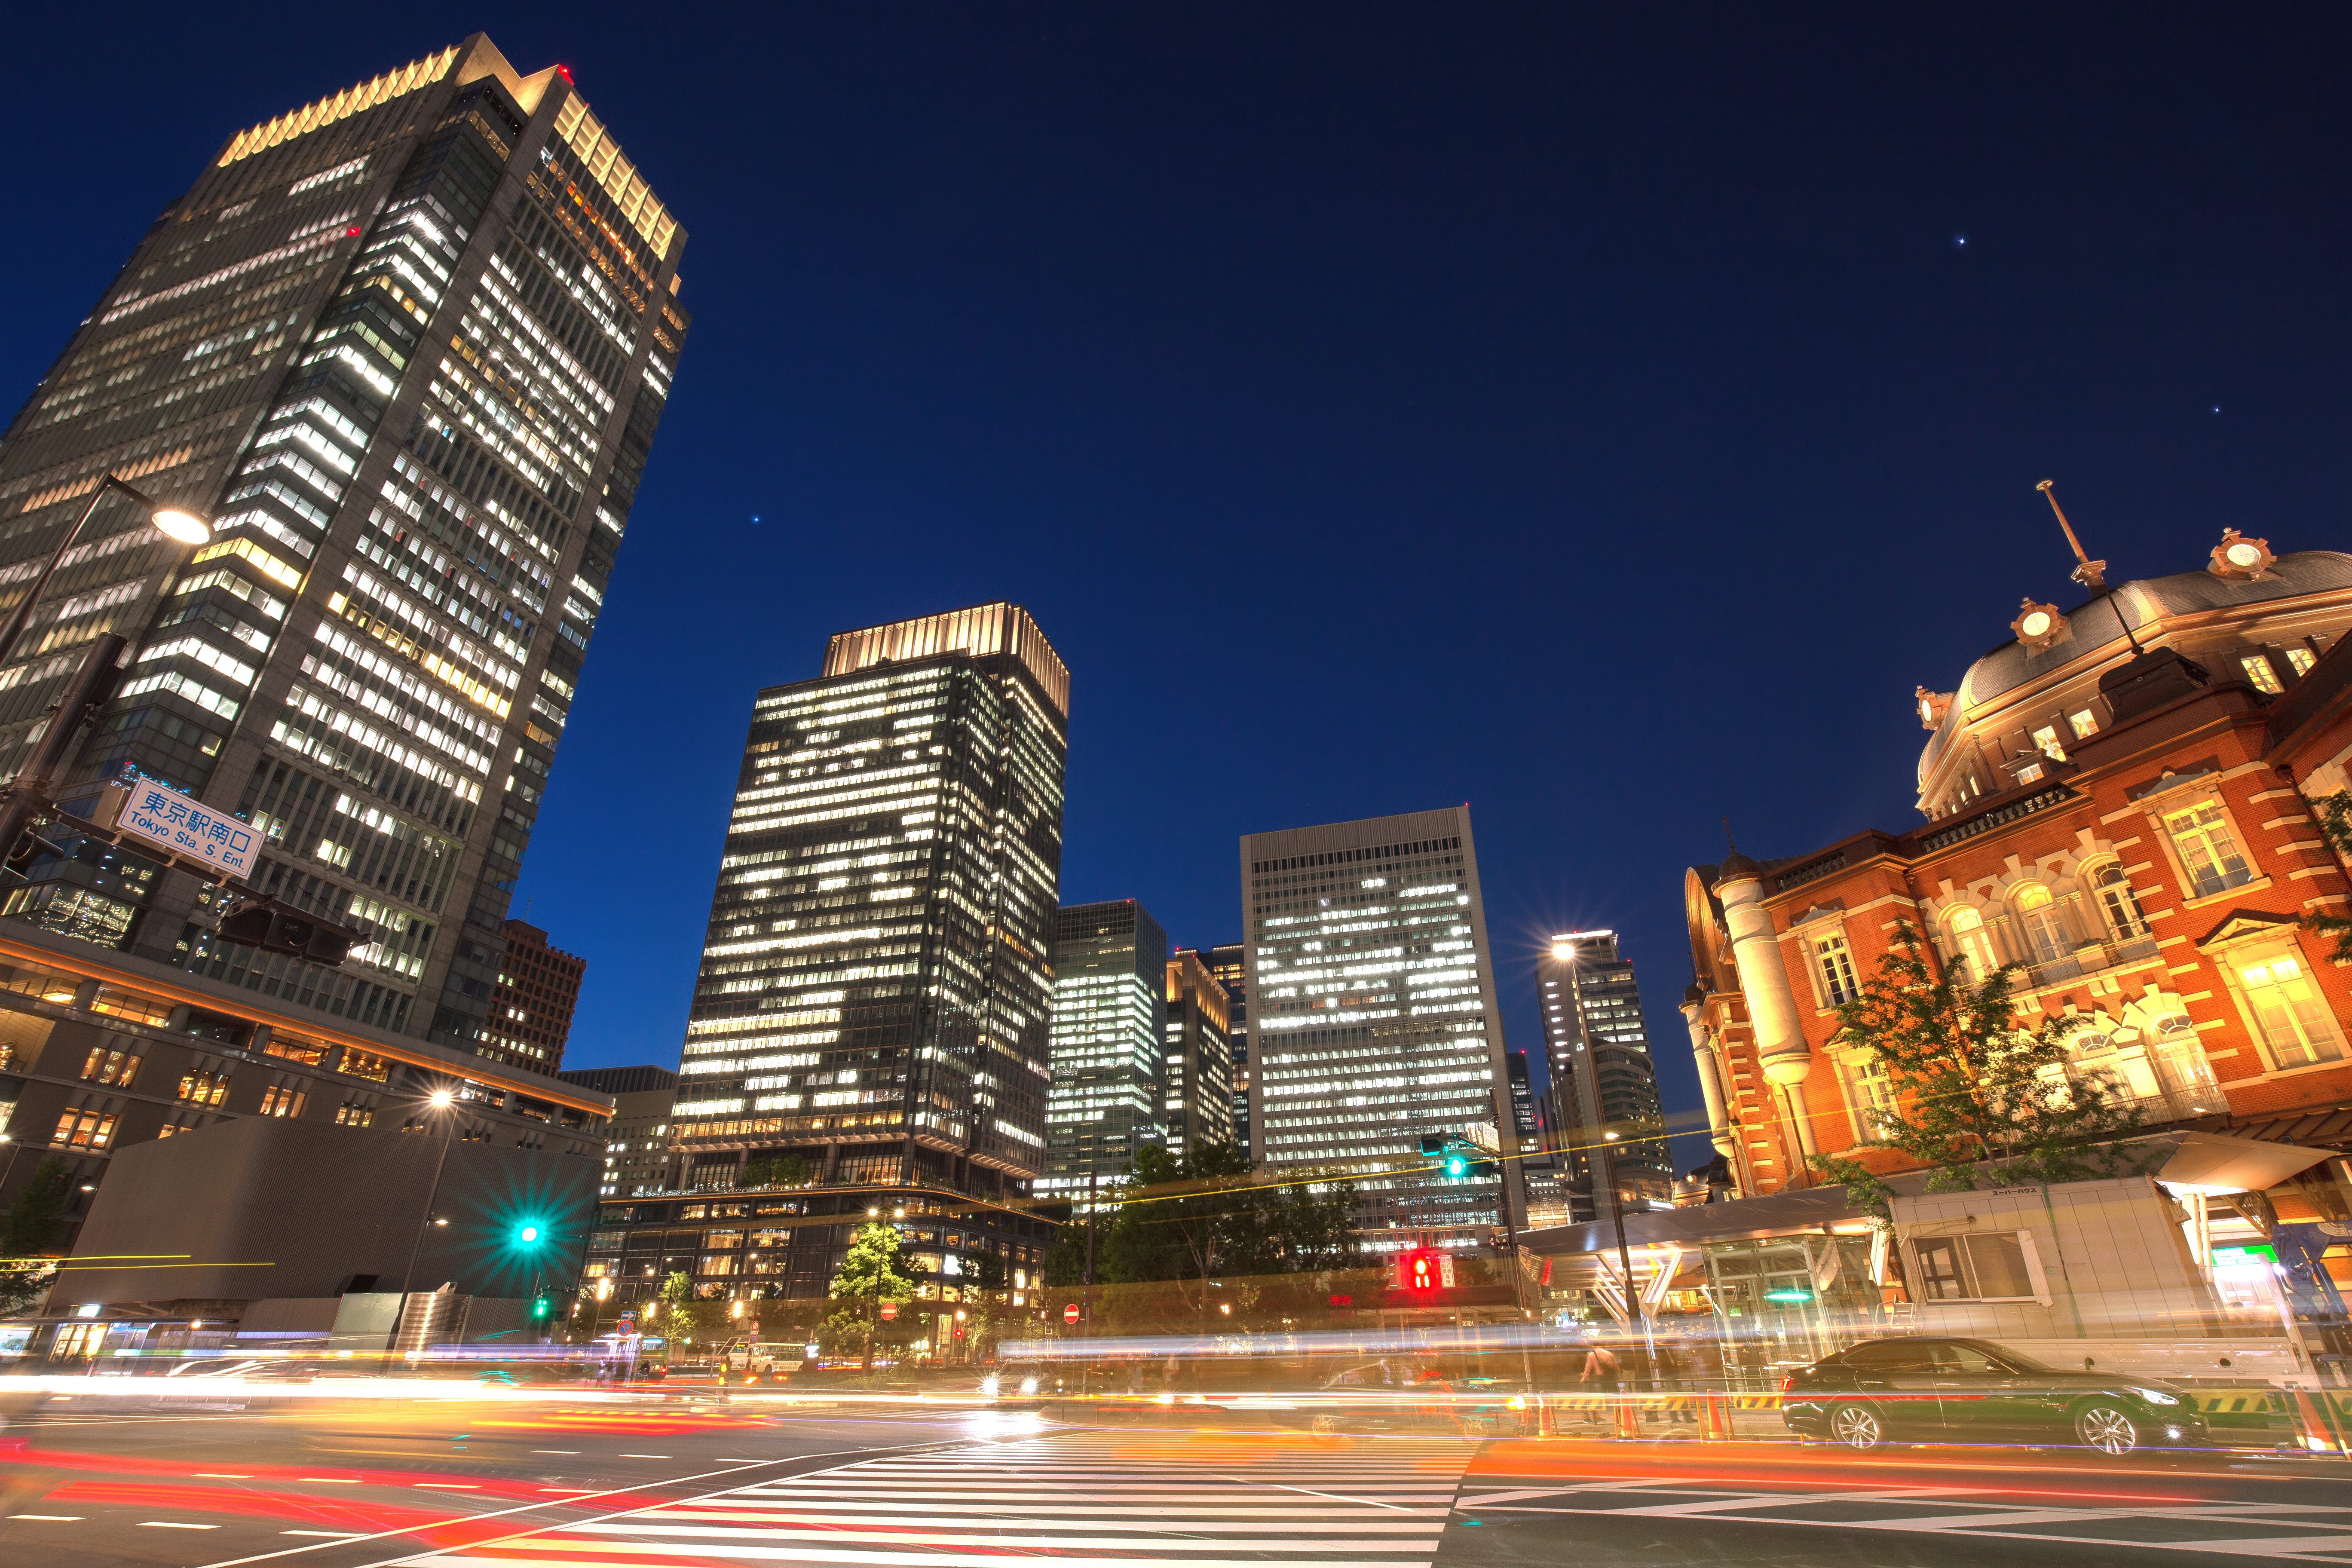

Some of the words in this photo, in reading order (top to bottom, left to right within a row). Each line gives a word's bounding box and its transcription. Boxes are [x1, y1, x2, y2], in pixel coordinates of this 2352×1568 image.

[131, 811, 169, 836] Tokyo
[175, 831, 198, 851] Sta.
[205, 845, 216, 858] S.
[222, 852, 245, 870] Ent.
[140, 790, 251, 853] 東京駅南口
